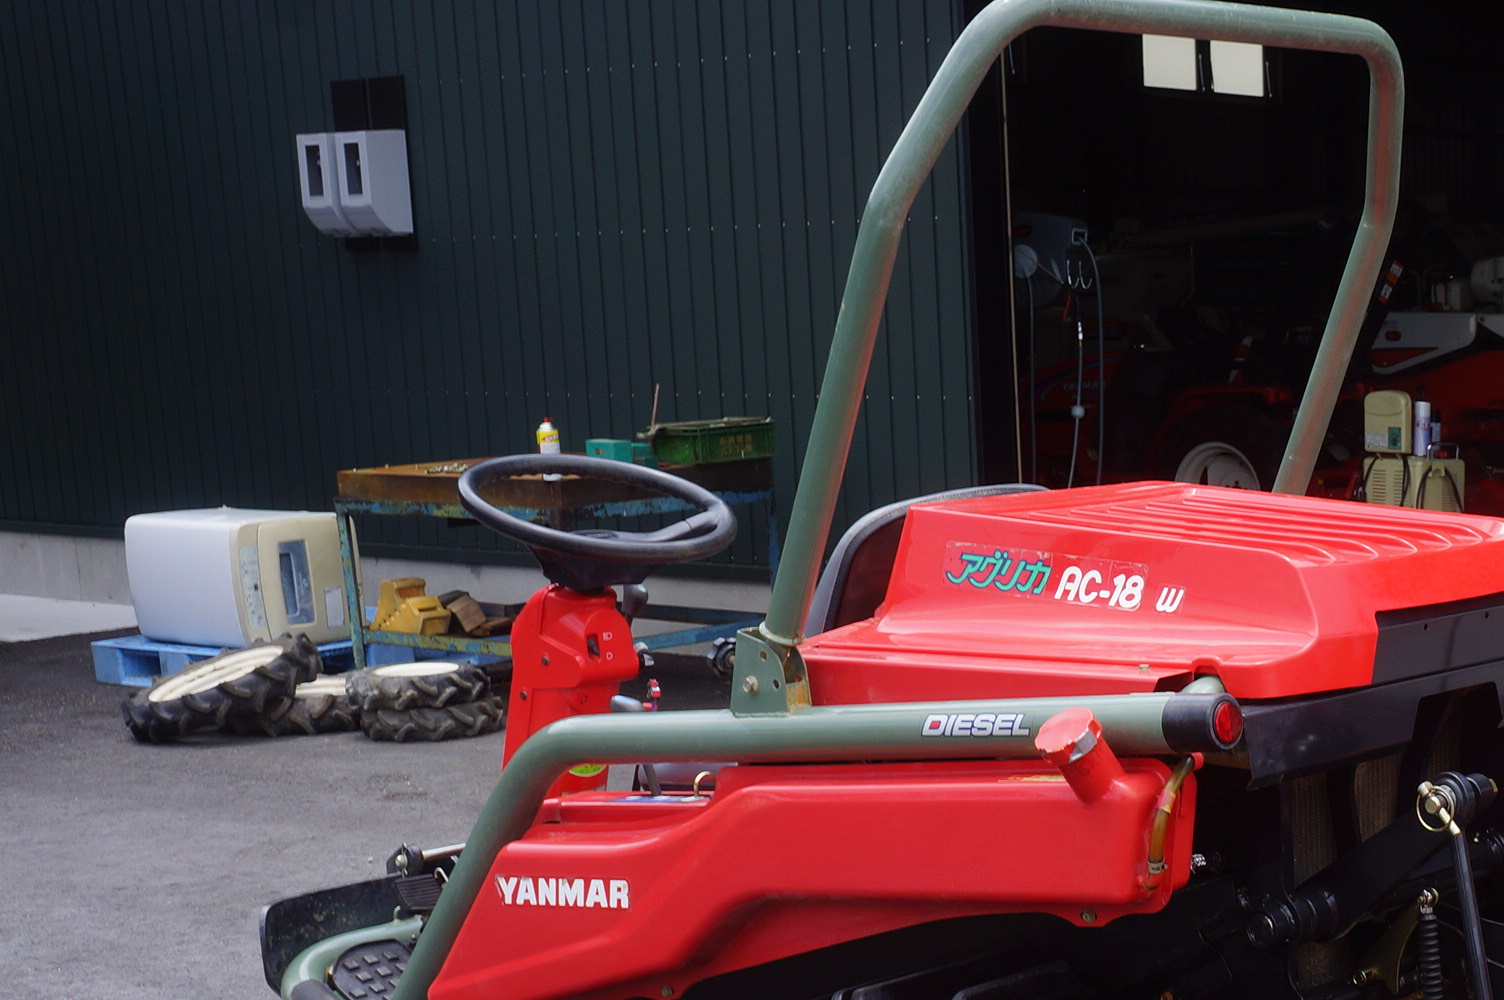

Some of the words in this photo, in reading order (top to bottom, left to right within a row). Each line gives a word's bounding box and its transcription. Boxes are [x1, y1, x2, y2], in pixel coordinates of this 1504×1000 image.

[946, 549, 1052, 594] アグリカ
[1054, 565, 1145, 609] AC-18
[921, 713, 1030, 737] DIESEL
[496, 876, 629, 909] YANMAR
